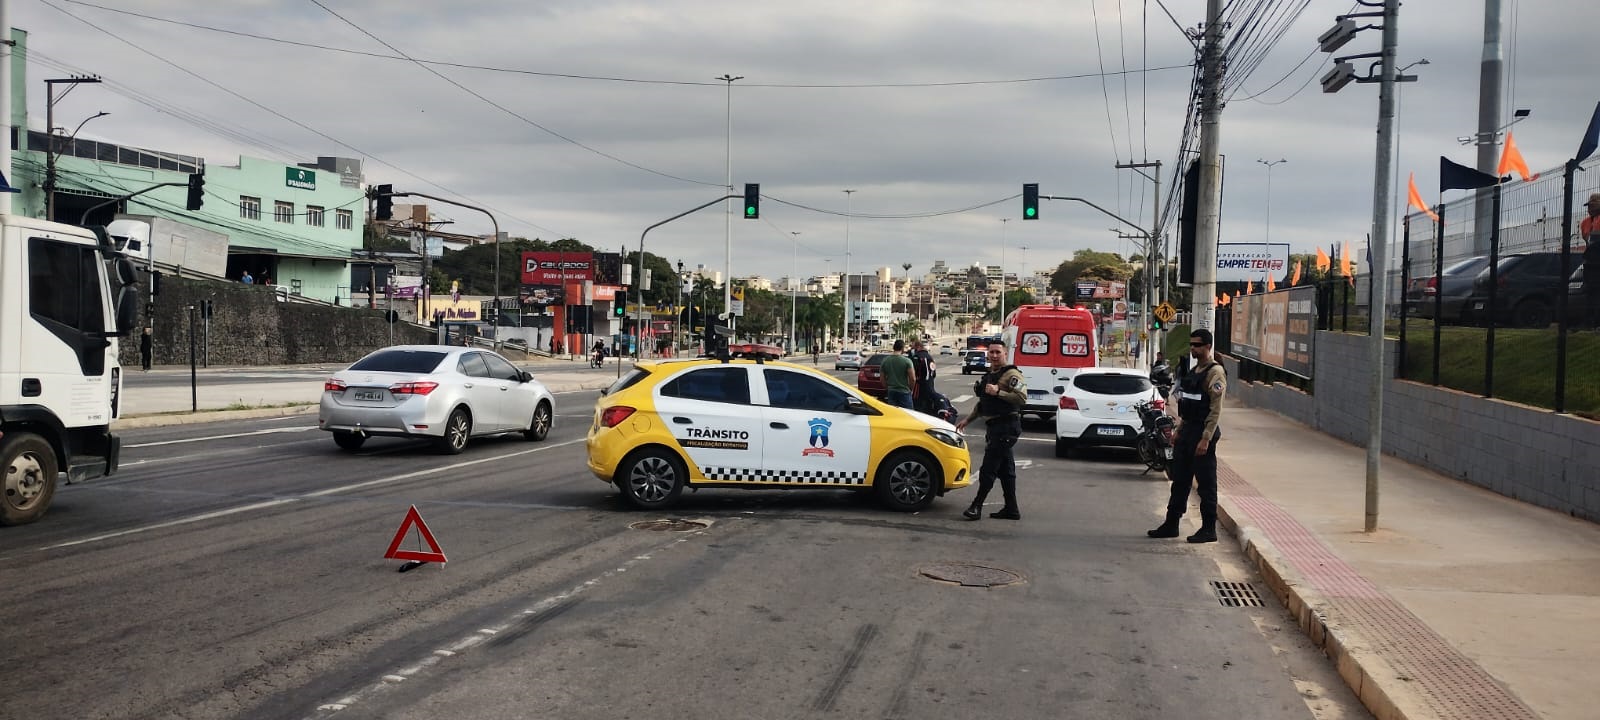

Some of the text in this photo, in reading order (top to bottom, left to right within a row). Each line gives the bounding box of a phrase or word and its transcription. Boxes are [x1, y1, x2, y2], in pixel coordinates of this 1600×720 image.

[1250, 259, 1271, 269] TEM
[1066, 343, 1086, 354] 192
[686, 426, 749, 440] TRÂNSITO
